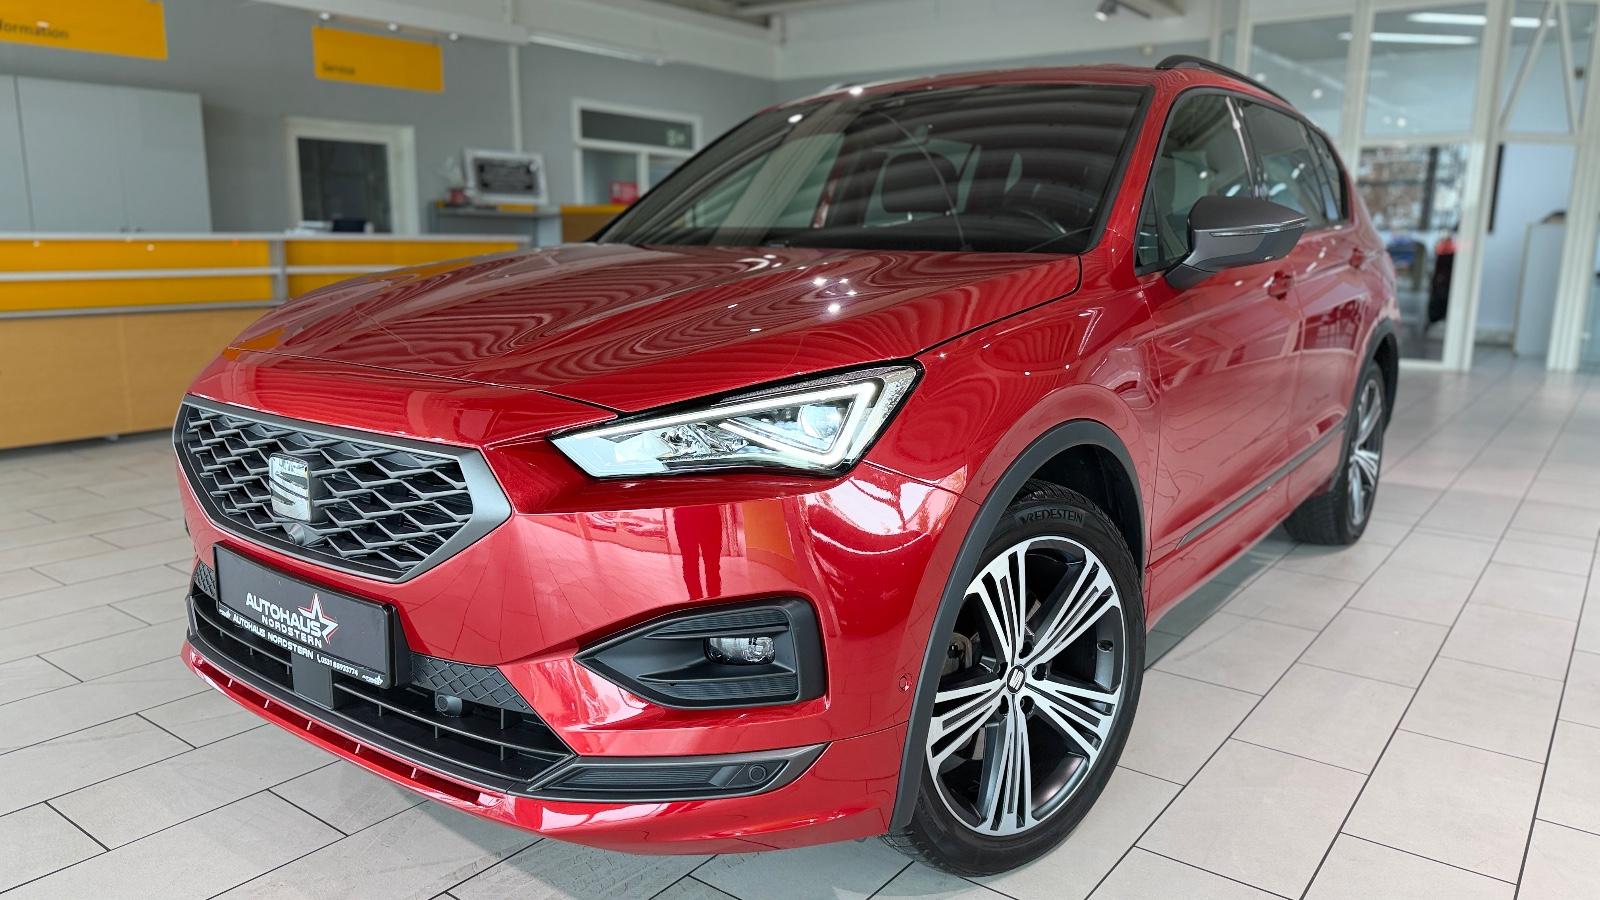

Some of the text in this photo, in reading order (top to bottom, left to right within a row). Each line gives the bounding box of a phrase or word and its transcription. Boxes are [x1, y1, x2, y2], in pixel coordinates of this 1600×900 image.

[1021, 508, 1083, 524] VREDESTEIN
[245, 592, 322, 638] AUTOHAUS
[261, 615, 323, 648] NORDSTERN
[232, 613, 267, 639] AUTOHAUS
[267, 631, 314, 660] NORDSTERN
